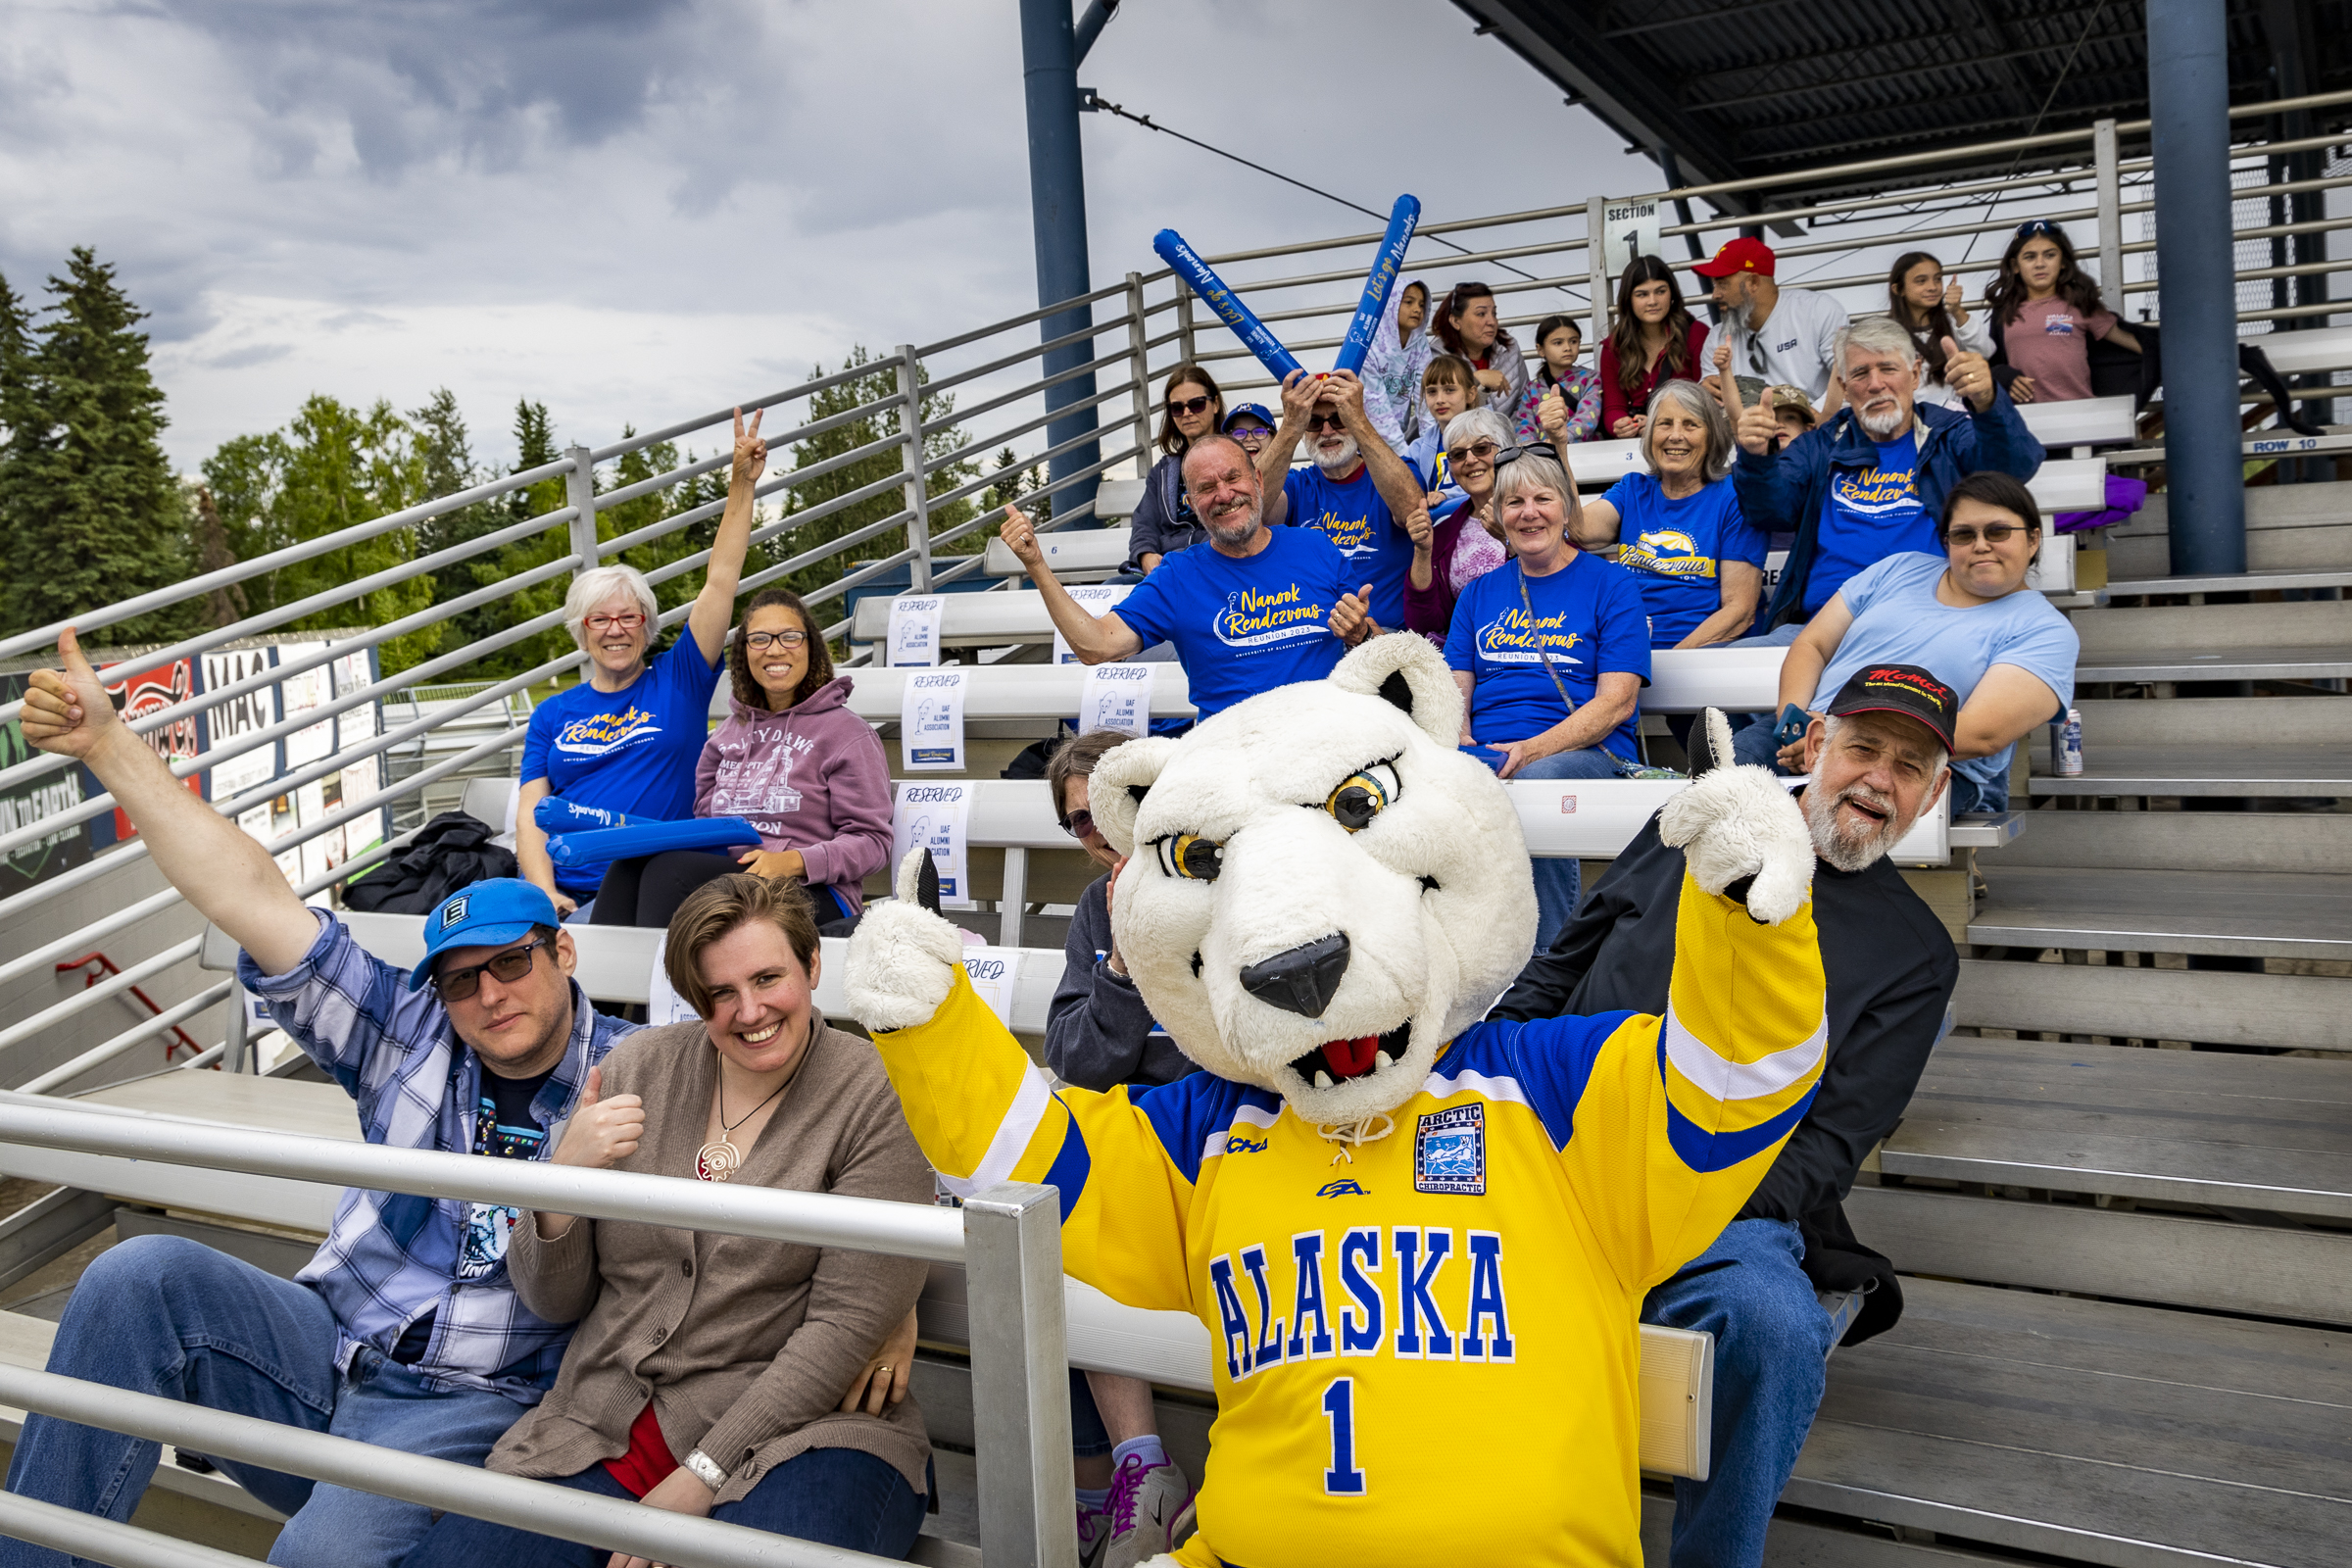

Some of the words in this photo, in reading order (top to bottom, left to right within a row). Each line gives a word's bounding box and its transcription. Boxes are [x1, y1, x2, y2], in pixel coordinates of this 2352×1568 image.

[1608, 204, 1655, 221] SECTION
[1382, 257, 1396, 277] go
[1391, 214, 1416, 261] Nanooks
[1623, 229, 1639, 263] 1
[1176, 244, 1214, 284] Nanooks
[1206, 290, 1228, 302] go
[1362, 314, 1373, 331] ALUMNI
[1777, 338, 1797, 353] USA
[2254, 440, 2290, 452] ROW
[2299, 438, 2317, 450] 10
[1626, 452, 1633, 461] 3
[1857, 467, 1916, 486] Nanook
[1323, 512, 1367, 531] Nanook
[1620, 545, 1708, 572] Rendezvous
[898, 600, 938, 612] RESERVED
[1242, 583, 1300, 612] Nanook
[1224, 604, 1325, 636] Rendezvous
[1248, 632, 1287, 644] REUNION
[1290, 626, 1311, 636] 2023
[1236, 649, 1266, 658] UNIVERSITY
[913, 674, 960, 688] RESERVED
[1096, 666, 1148, 680] RESERVED
[209, 652, 266, 740] MAC
[1104, 717, 1134, 726] ASSOCIATION
[771, 730, 814, 756] DAWG
[906, 787, 962, 803] RESERVED
[568, 802, 611, 826] Nanooks
[940, 825, 951, 834] UAF
[1421, 1106, 1480, 1127] ARCTIC
[1418, 1183, 1482, 1193] CHIROPRACTIC
[1209, 1225, 1516, 1384] ALASKA
[1322, 1377, 1368, 1496] 1
